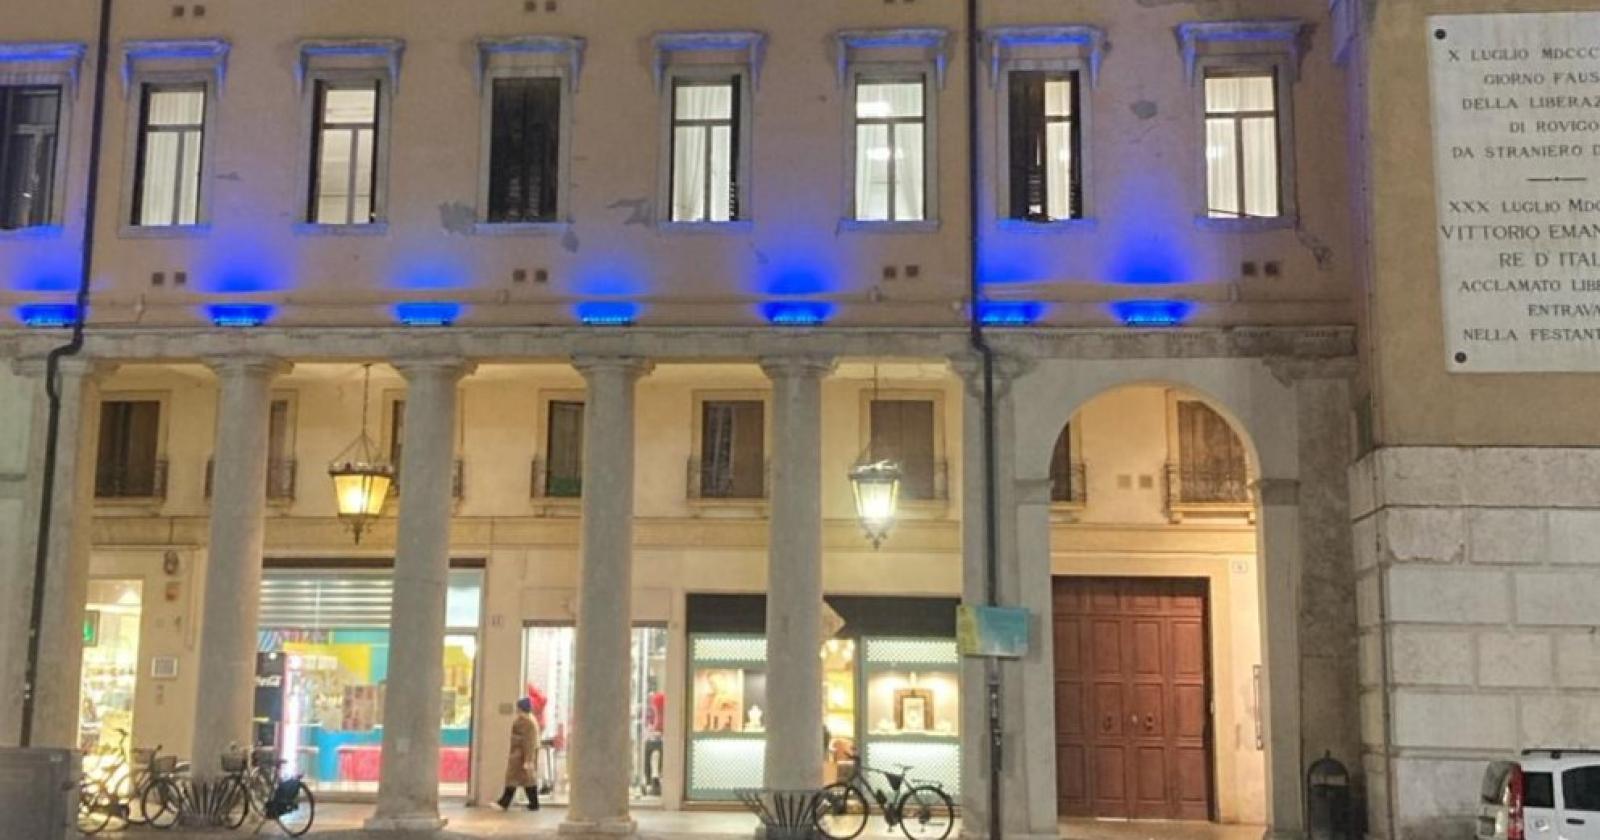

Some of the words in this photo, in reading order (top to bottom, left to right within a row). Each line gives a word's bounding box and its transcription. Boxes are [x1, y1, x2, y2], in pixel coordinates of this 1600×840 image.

[1448, 49, 1460, 62] X
[1470, 49, 1529, 61] LUGLIO
[1483, 73, 1545, 85] GIORNO
[1552, 72, 1600, 84] FAUS
[1462, 97, 1519, 110] DELLA
[1509, 121, 1525, 133] DI
[1535, 119, 1600, 133] ROVIGO
[1452, 146, 1475, 159] DA
[1485, 144, 1583, 158] STRANIERO
[1449, 199, 1490, 213] XXX
[1501, 200, 1561, 213] LUGLIO
[1440, 224, 1540, 241] VITTORIO
[1499, 252, 1523, 268] RE
[1559, 251, 1600, 268] ITAL
[1459, 279, 1561, 293] ACCLAMATO
[1463, 328, 1519, 341] NELLA
